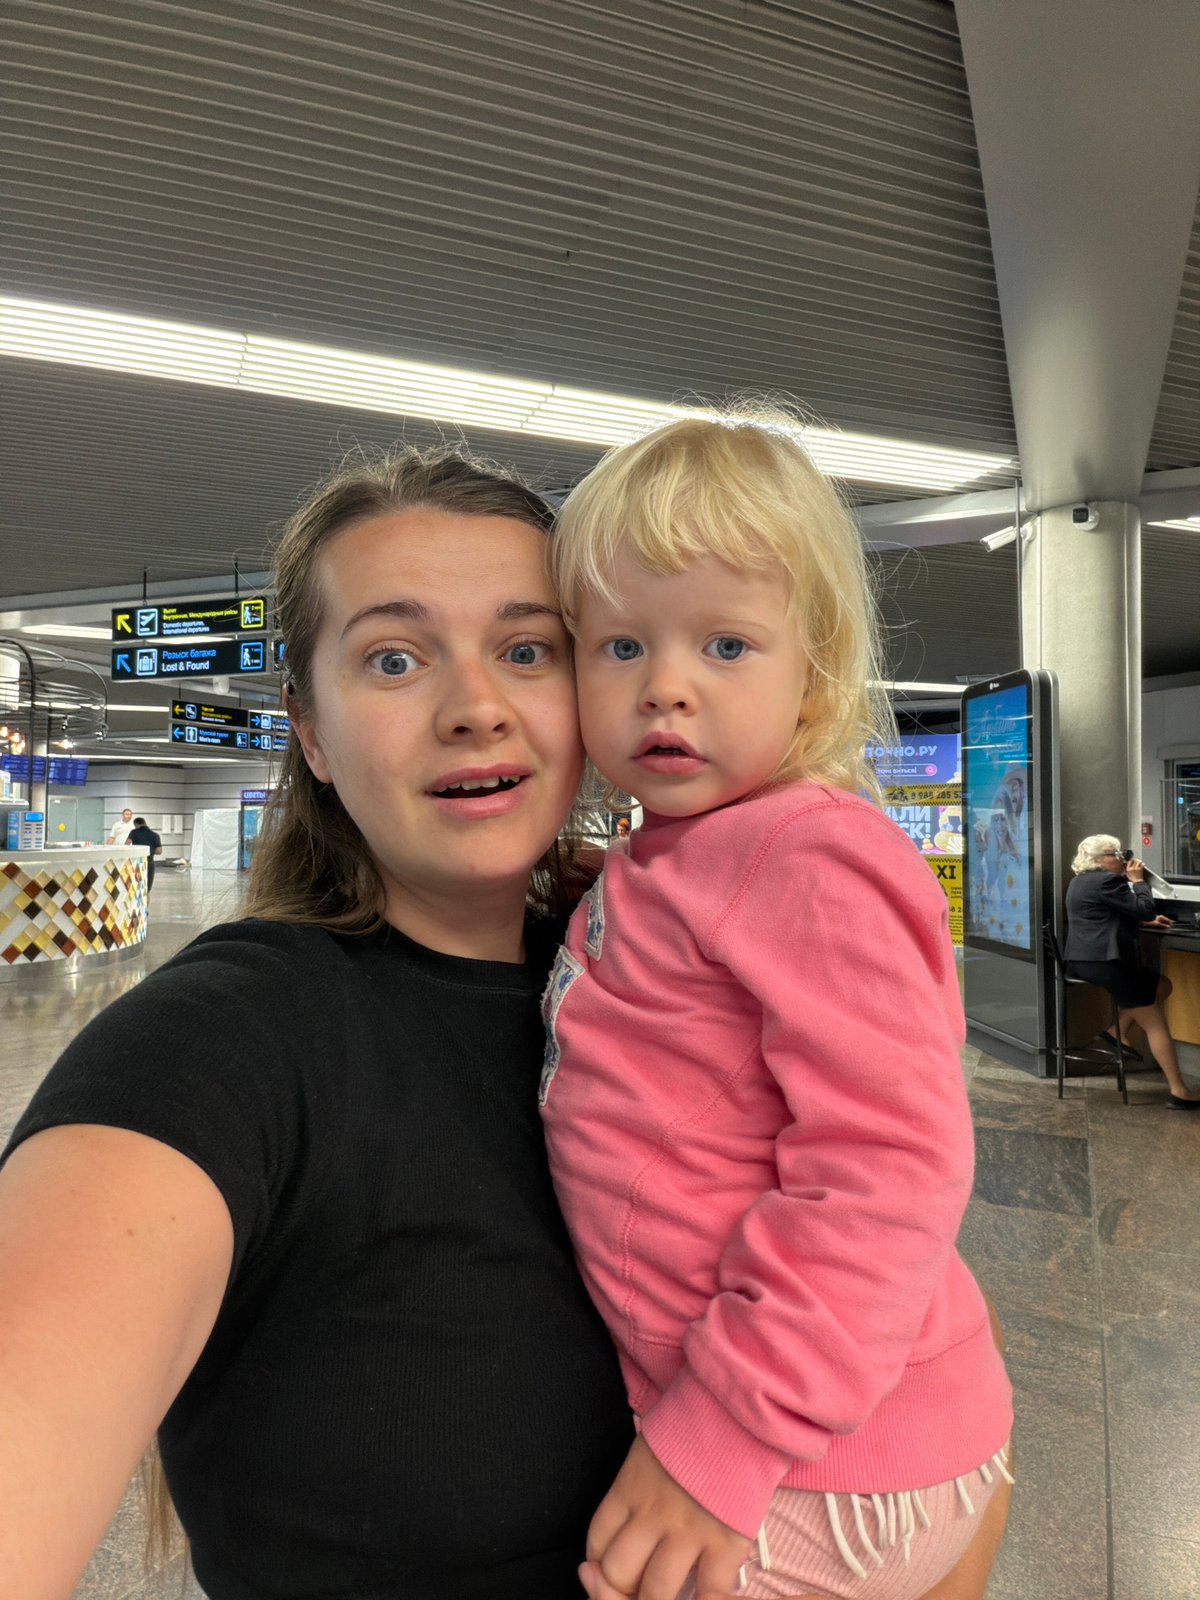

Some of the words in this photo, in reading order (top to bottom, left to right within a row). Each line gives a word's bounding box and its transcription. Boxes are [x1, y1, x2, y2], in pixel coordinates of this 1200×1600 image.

[162, 650, 189, 659] Розыск
[190, 648, 216, 658] багажа
[162, 662, 178, 672] Lost
[178, 662, 185, 671] &
[186, 660, 210, 671] Found
[866, 746, 937, 757] ТОЧНО.РУ
[885, 806, 930, 822] АЛИ
[896, 822, 931, 838] СК!
[937, 865, 956, 879] XI
